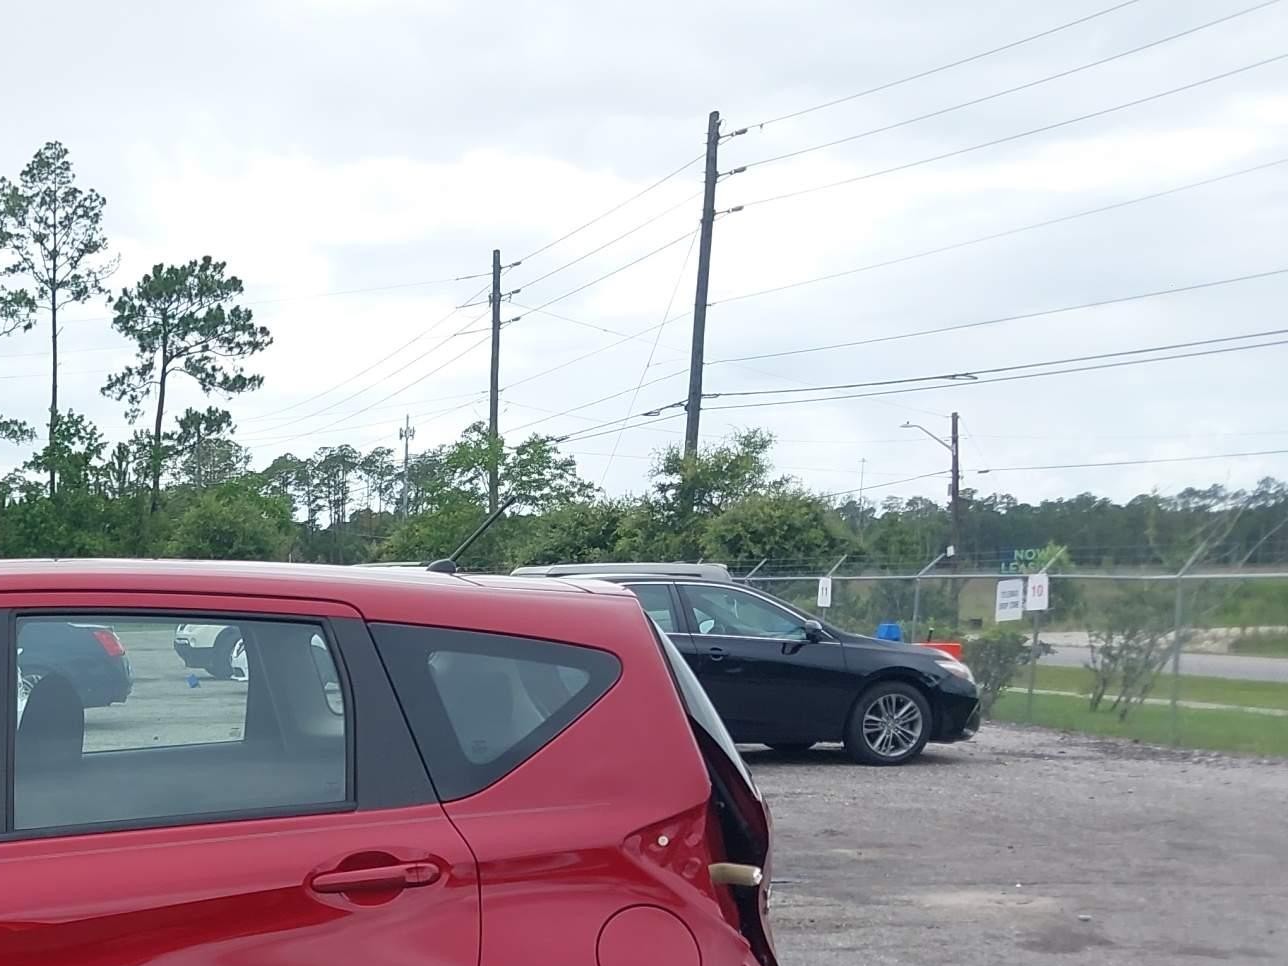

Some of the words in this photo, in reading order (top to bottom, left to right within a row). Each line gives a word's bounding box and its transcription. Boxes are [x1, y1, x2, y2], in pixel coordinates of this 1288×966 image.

[1014, 549, 1050, 561] NOW
[821, 586, 828, 597] 11
[1031, 584, 1044, 597] 10
